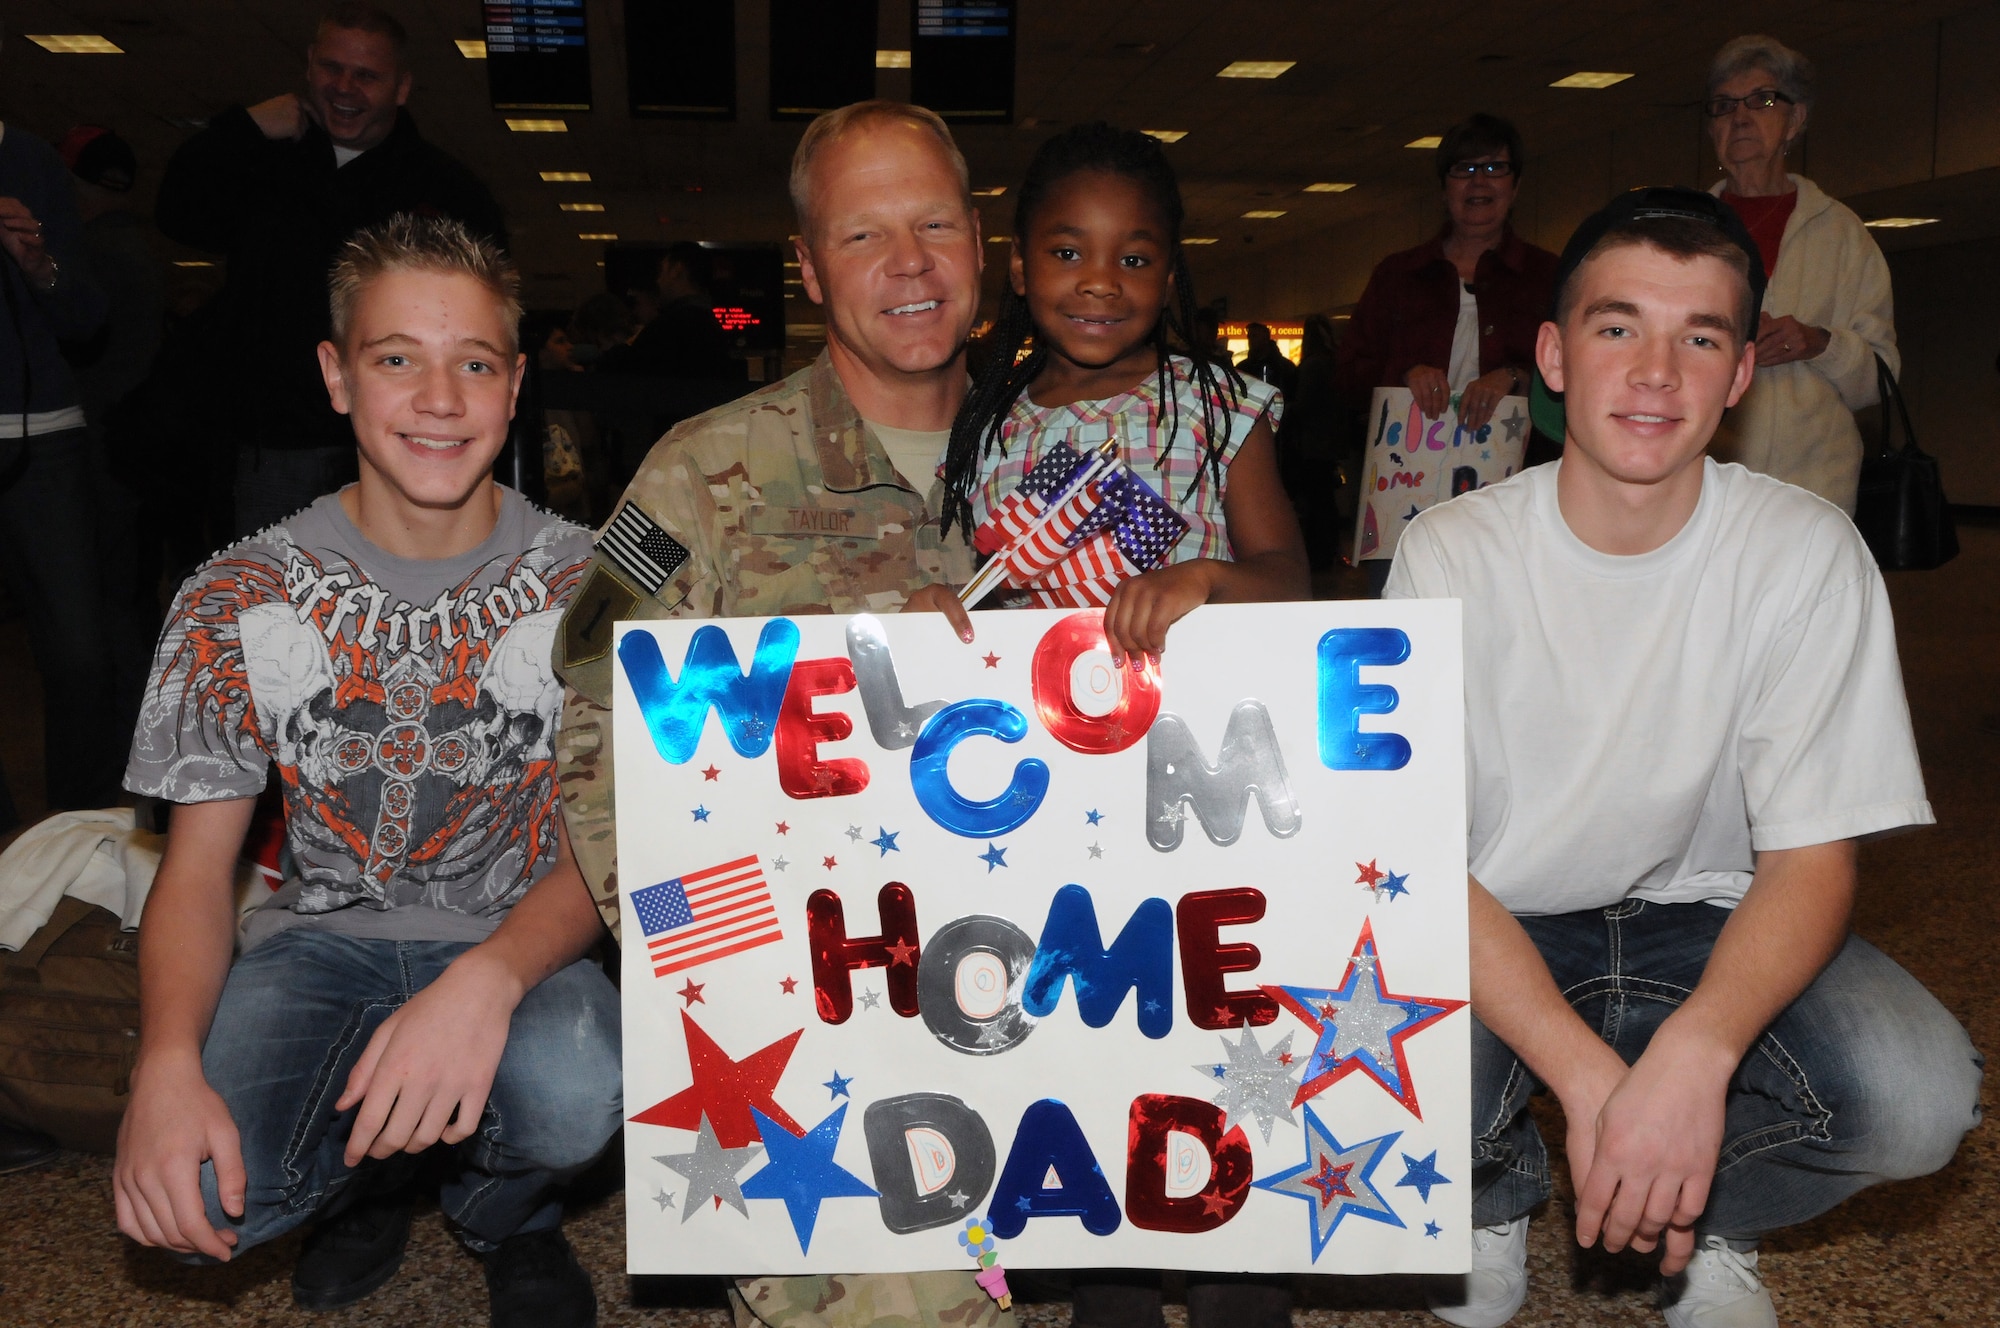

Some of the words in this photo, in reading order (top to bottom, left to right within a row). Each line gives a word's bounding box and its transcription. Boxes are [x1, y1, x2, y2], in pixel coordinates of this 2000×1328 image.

[1226, 325, 1242, 335] the
[788, 509, 850, 531] TAYLOR
[806, 881, 1279, 1056] HOME
[864, 1092, 1253, 1239] DAD
